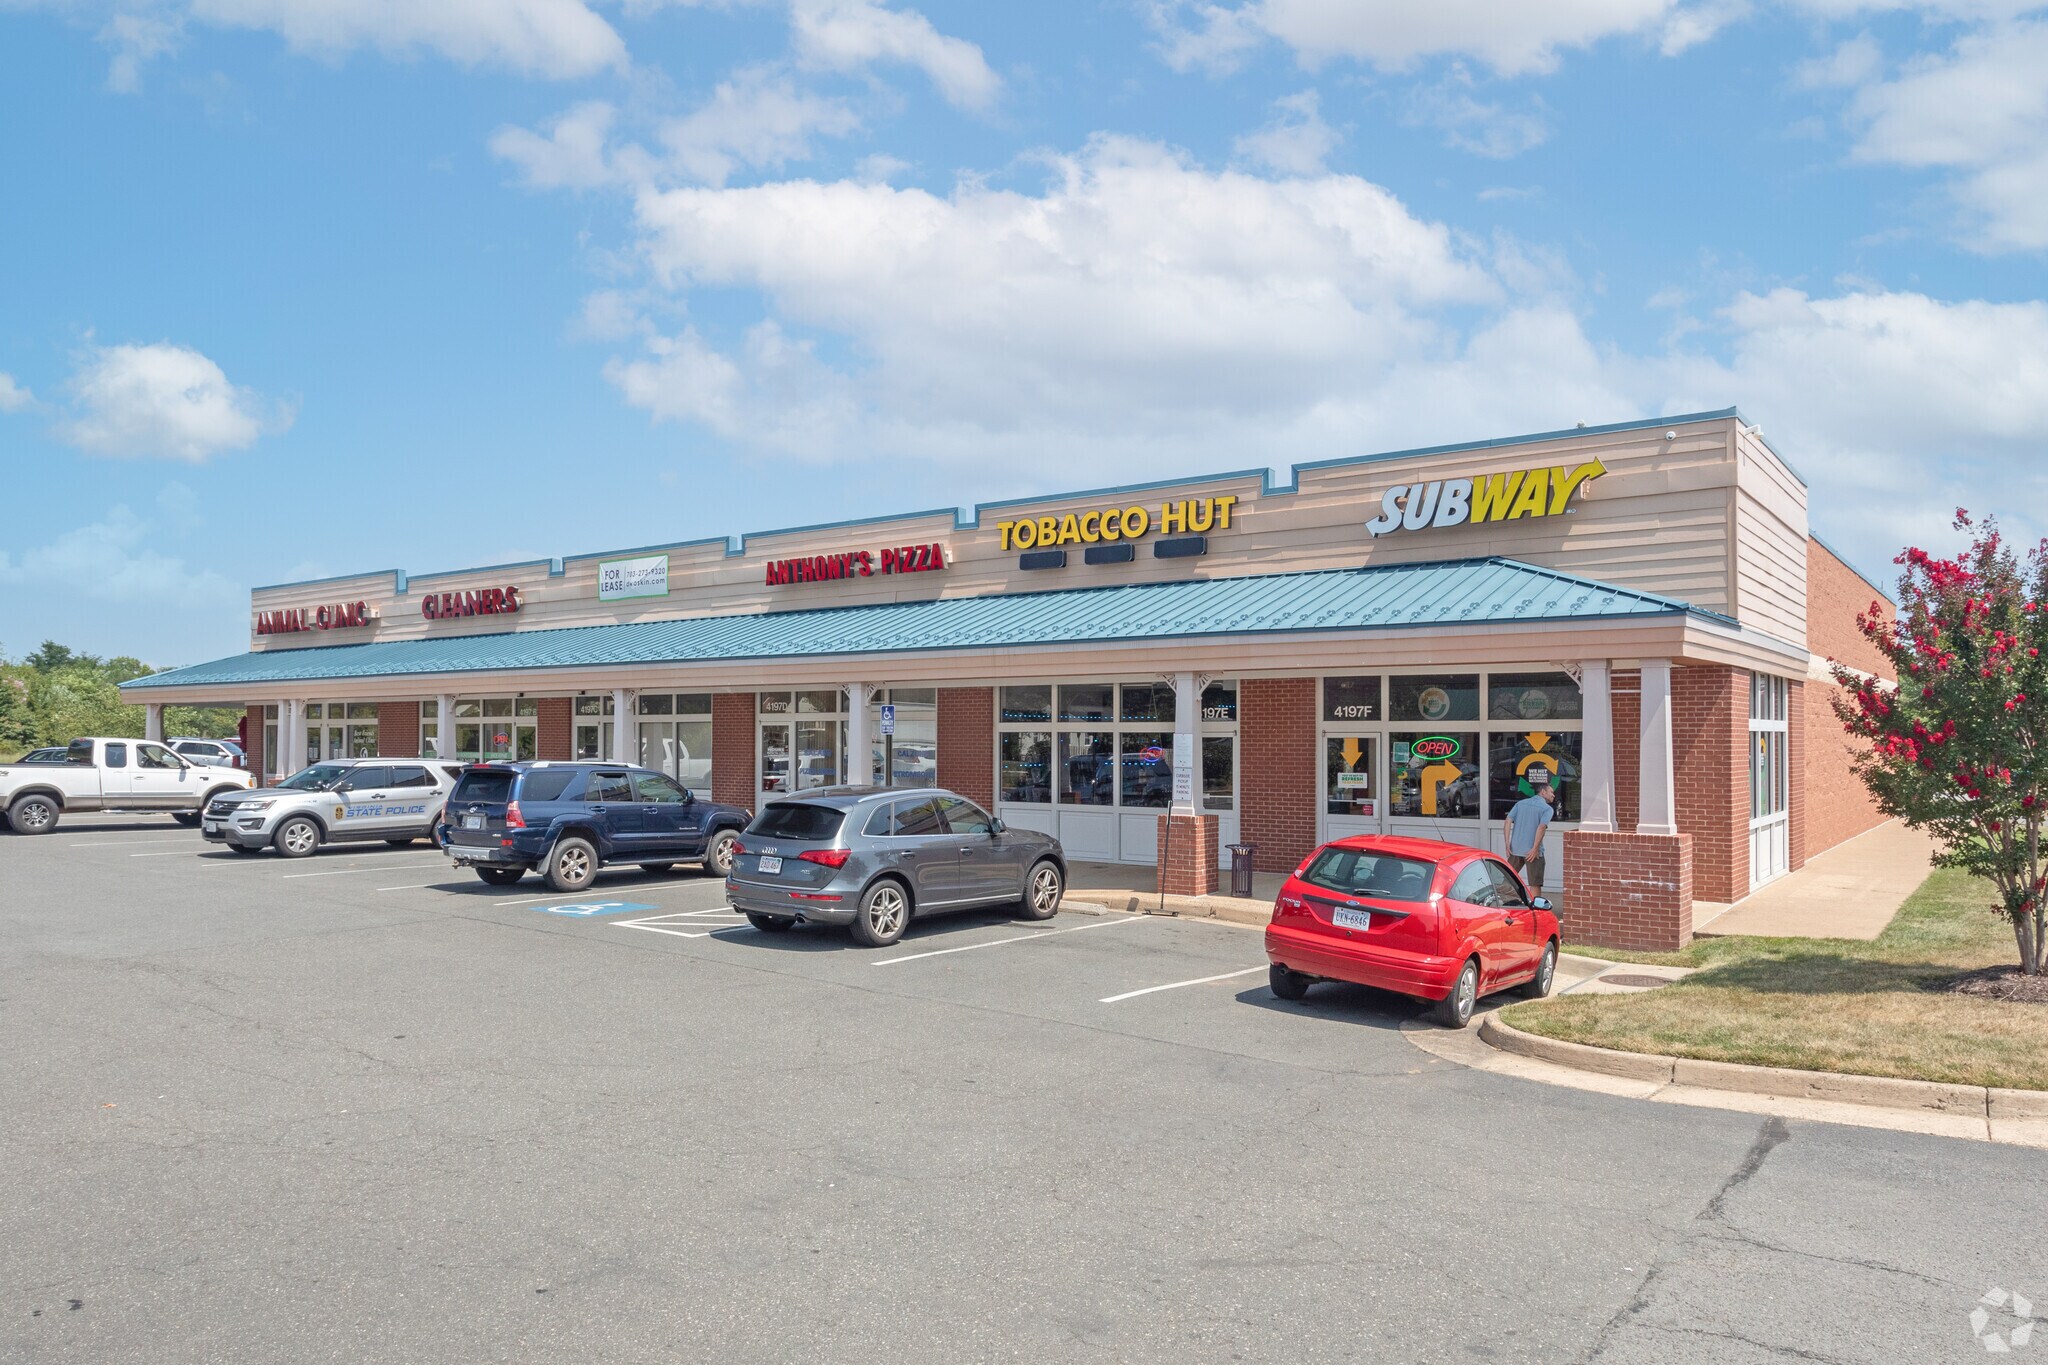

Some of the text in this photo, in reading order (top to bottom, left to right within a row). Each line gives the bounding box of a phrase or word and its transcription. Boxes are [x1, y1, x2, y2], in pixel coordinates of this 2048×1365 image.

[1365, 456, 1608, 538] SUBWAY
[997, 495, 1239, 550] TOBACCO HUT
[766, 543, 947, 586] ANTHONY'S PIZZA
[604, 570, 620, 580] FOR
[626, 567, 666, 578] 703-273-9320
[601, 581, 623, 592] LEASE
[626, 578, 666, 588] dwoskin.com
[421, 586, 519, 620] CLEANERS
[257, 601, 370, 635] ANIMAL CLINIC
[766, 702, 788, 711] 4197D
[1201, 707, 1229, 719] 197E
[1334, 705, 1373, 718] 4197F
[1417, 741, 1453, 755] OPEN
[346, 805, 426, 818] STATE POLICE
